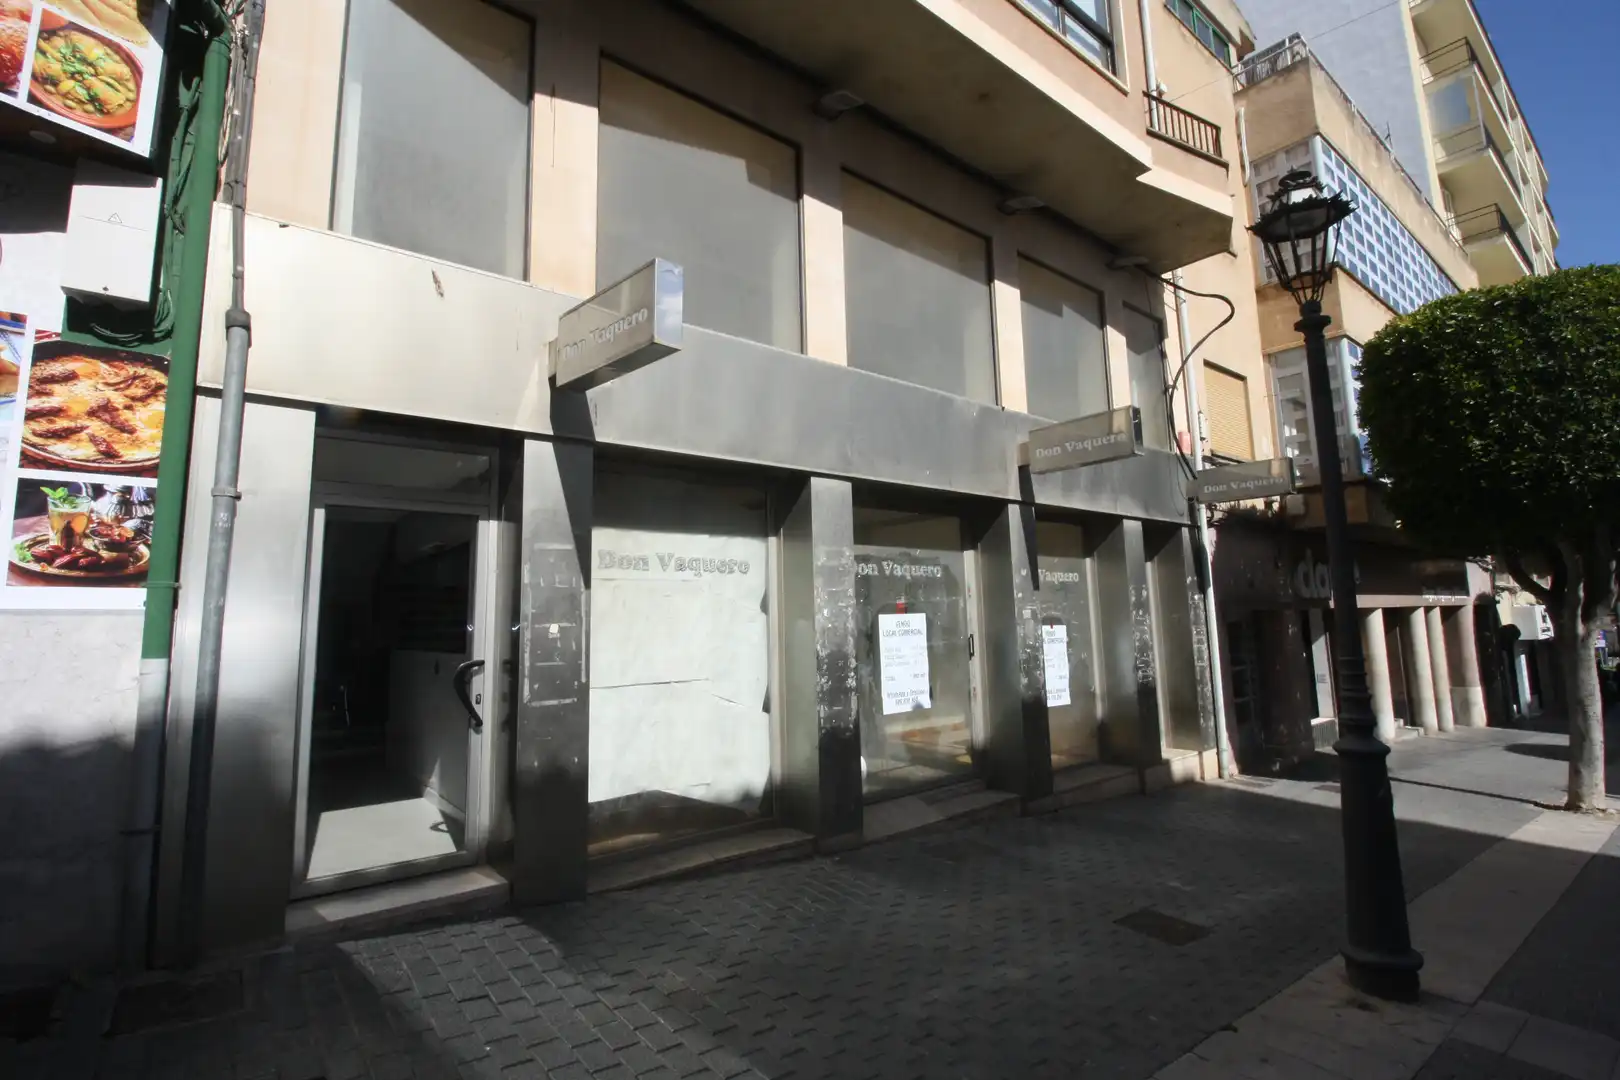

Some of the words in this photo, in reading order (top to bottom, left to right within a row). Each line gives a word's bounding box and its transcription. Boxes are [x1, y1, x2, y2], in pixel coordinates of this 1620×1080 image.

[589, 307, 648, 343] Vaquero
[1035, 446, 1061, 457] Don
[1064, 433, 1127, 451] Vaquero
[1203, 484, 1228, 493] Don
[1230, 477, 1284, 490] Vaquero
[597, 549, 649, 571] Don
[655, 552, 750, 577] Vaquero
[854, 559, 879, 576] on
[881, 560, 942, 580] Vaquero
[1038, 569, 1079, 584] Vaquero
